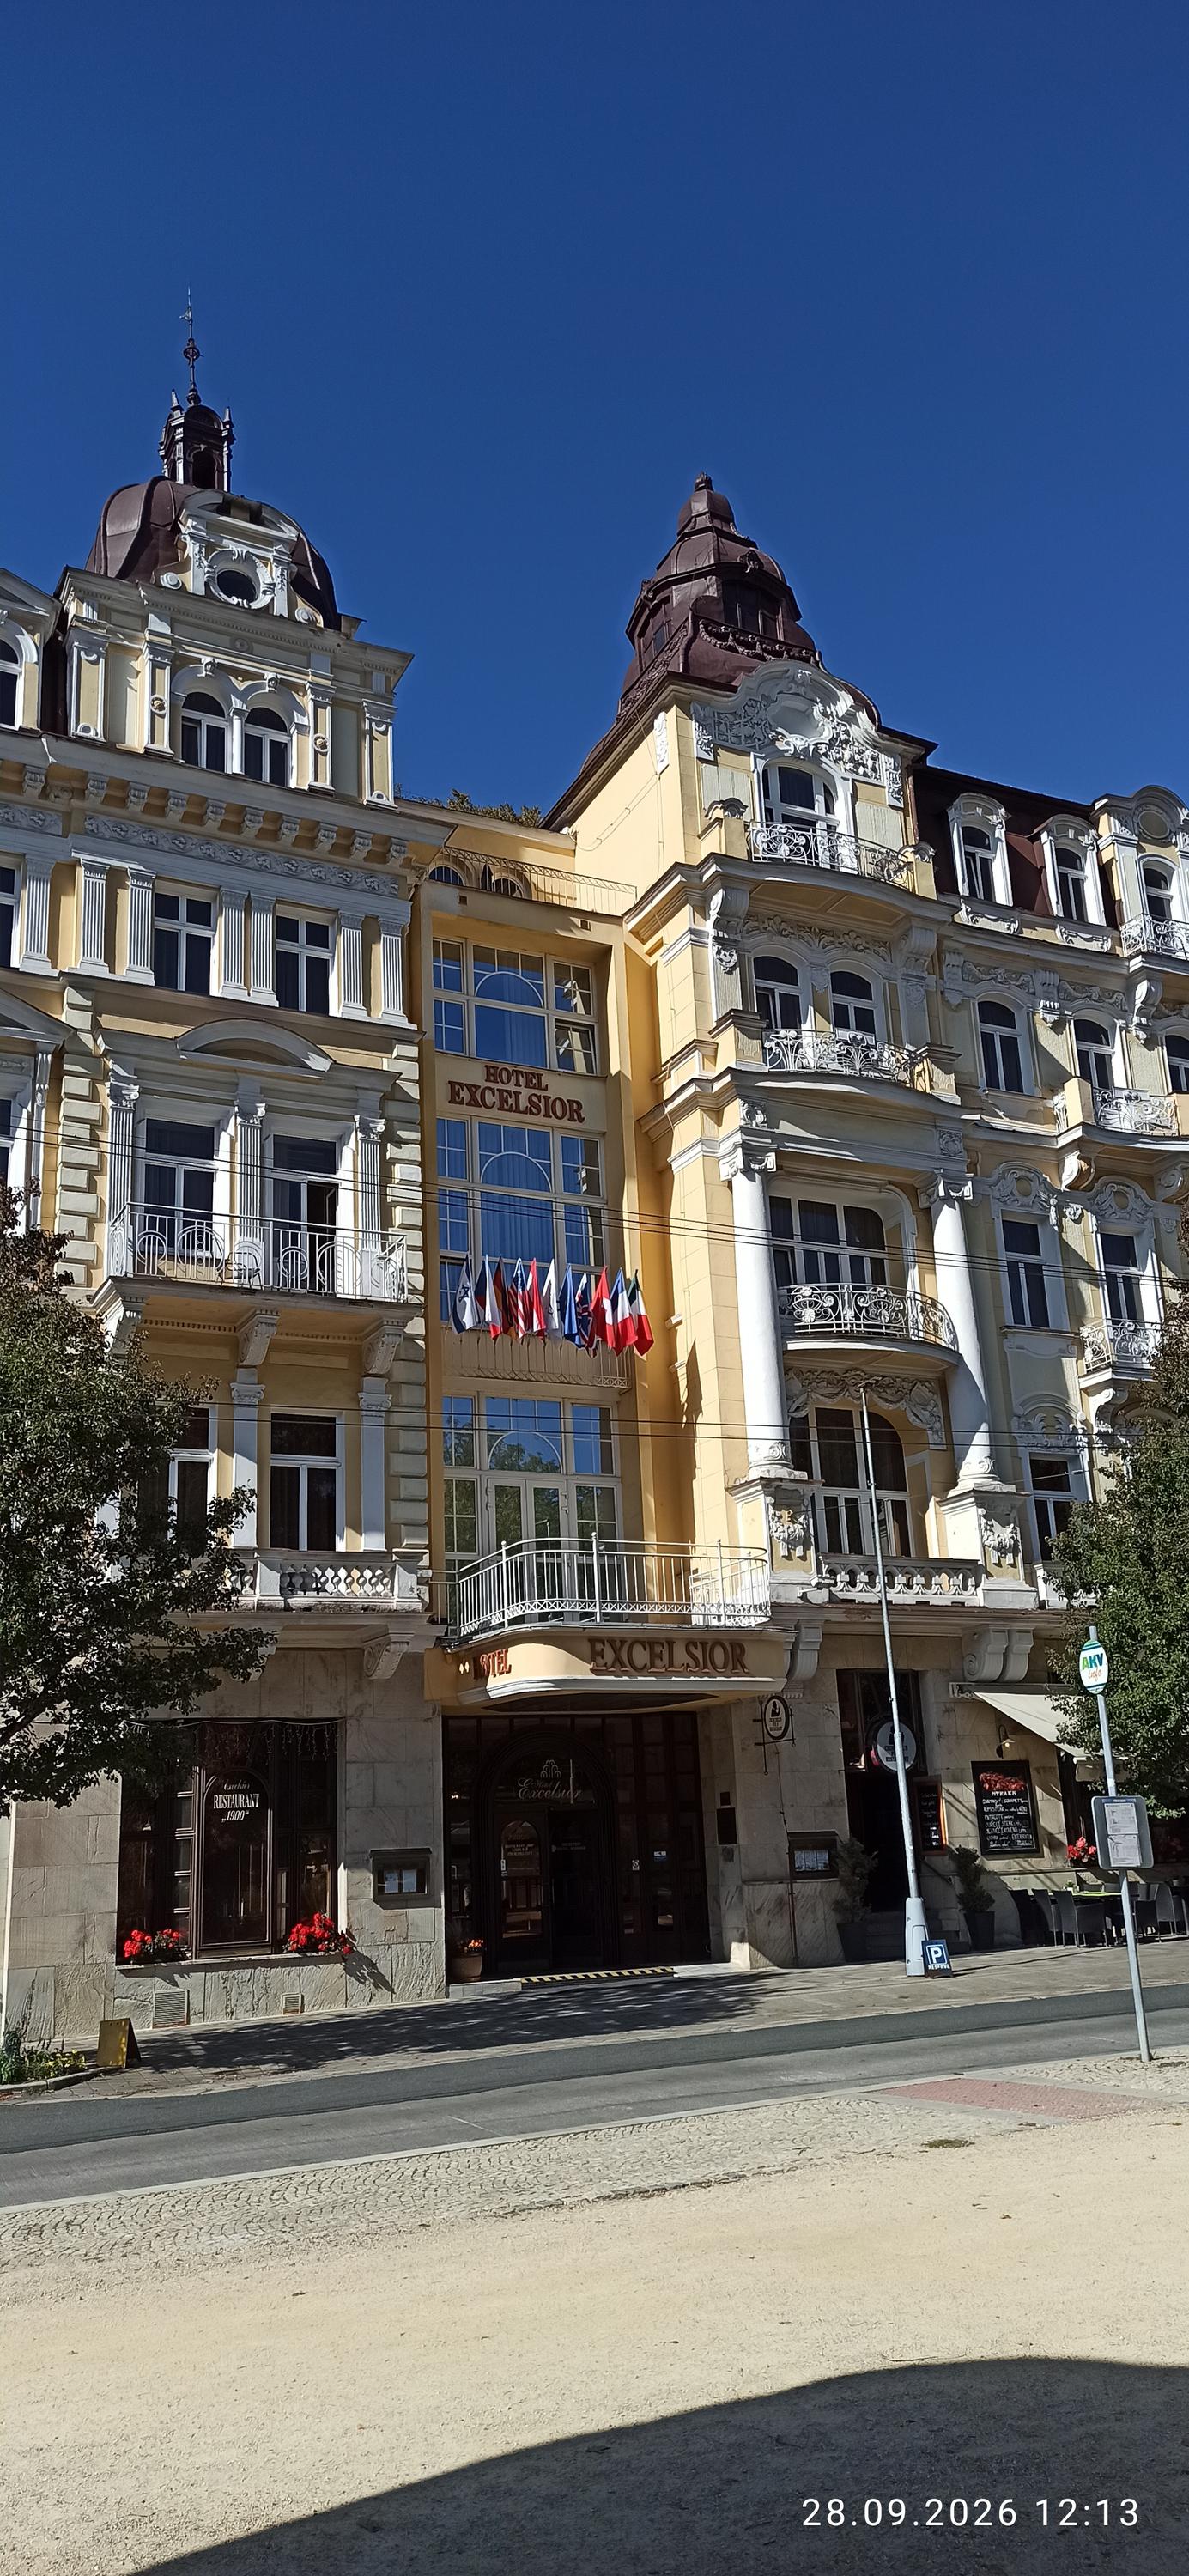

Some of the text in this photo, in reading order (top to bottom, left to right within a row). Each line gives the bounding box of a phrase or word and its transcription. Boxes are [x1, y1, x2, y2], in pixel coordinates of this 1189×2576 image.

[484, 1065, 548, 1091] HOTEL
[447, 1080, 585, 1123] EXCELSIOR
[473, 1637, 750, 1680] HOTEL EXCELSIOR
[1088, 1667, 1102, 1682] info
[213, 1793, 260, 1809] RESTAURANT
[517, 1777, 583, 1801] Excelsior
[930, 1947, 943, 1964] P
